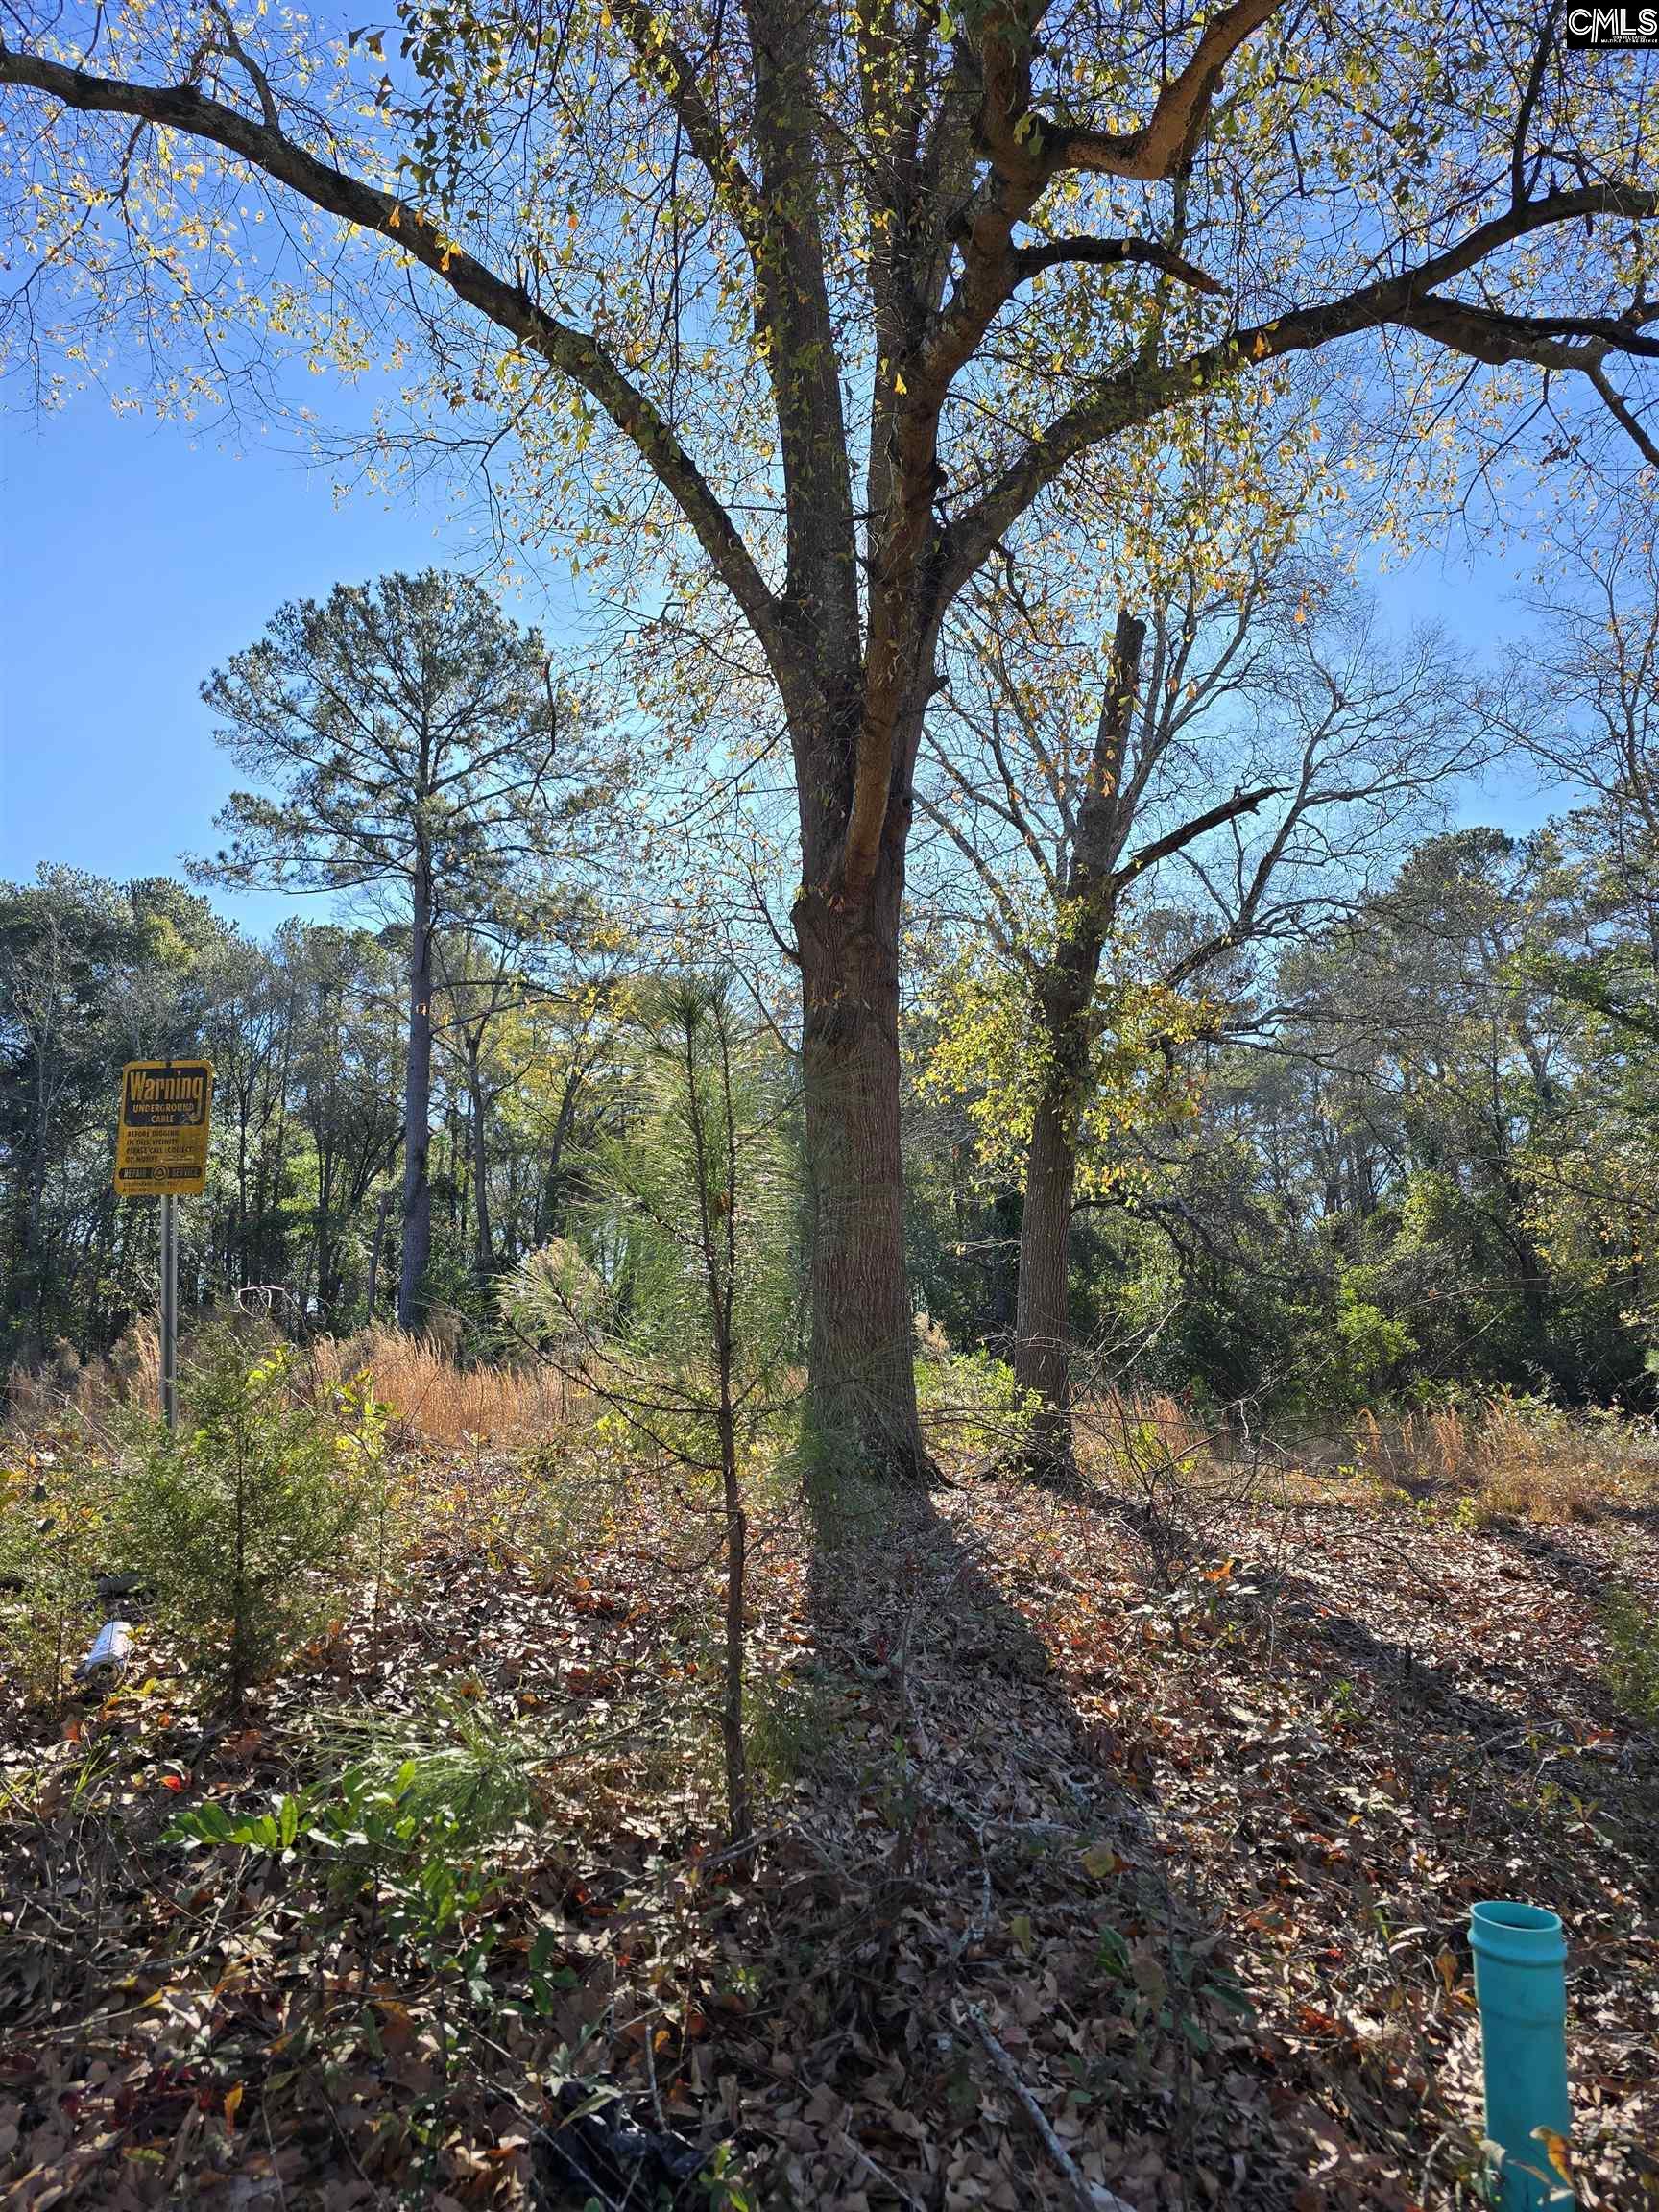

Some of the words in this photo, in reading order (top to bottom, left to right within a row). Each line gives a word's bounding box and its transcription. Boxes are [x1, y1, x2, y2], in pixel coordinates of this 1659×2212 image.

[130, 1070, 204, 1119] Warning
[132, 1103, 194, 1114] UNDERGROUND
[151, 1114, 175, 1123] CABLE
